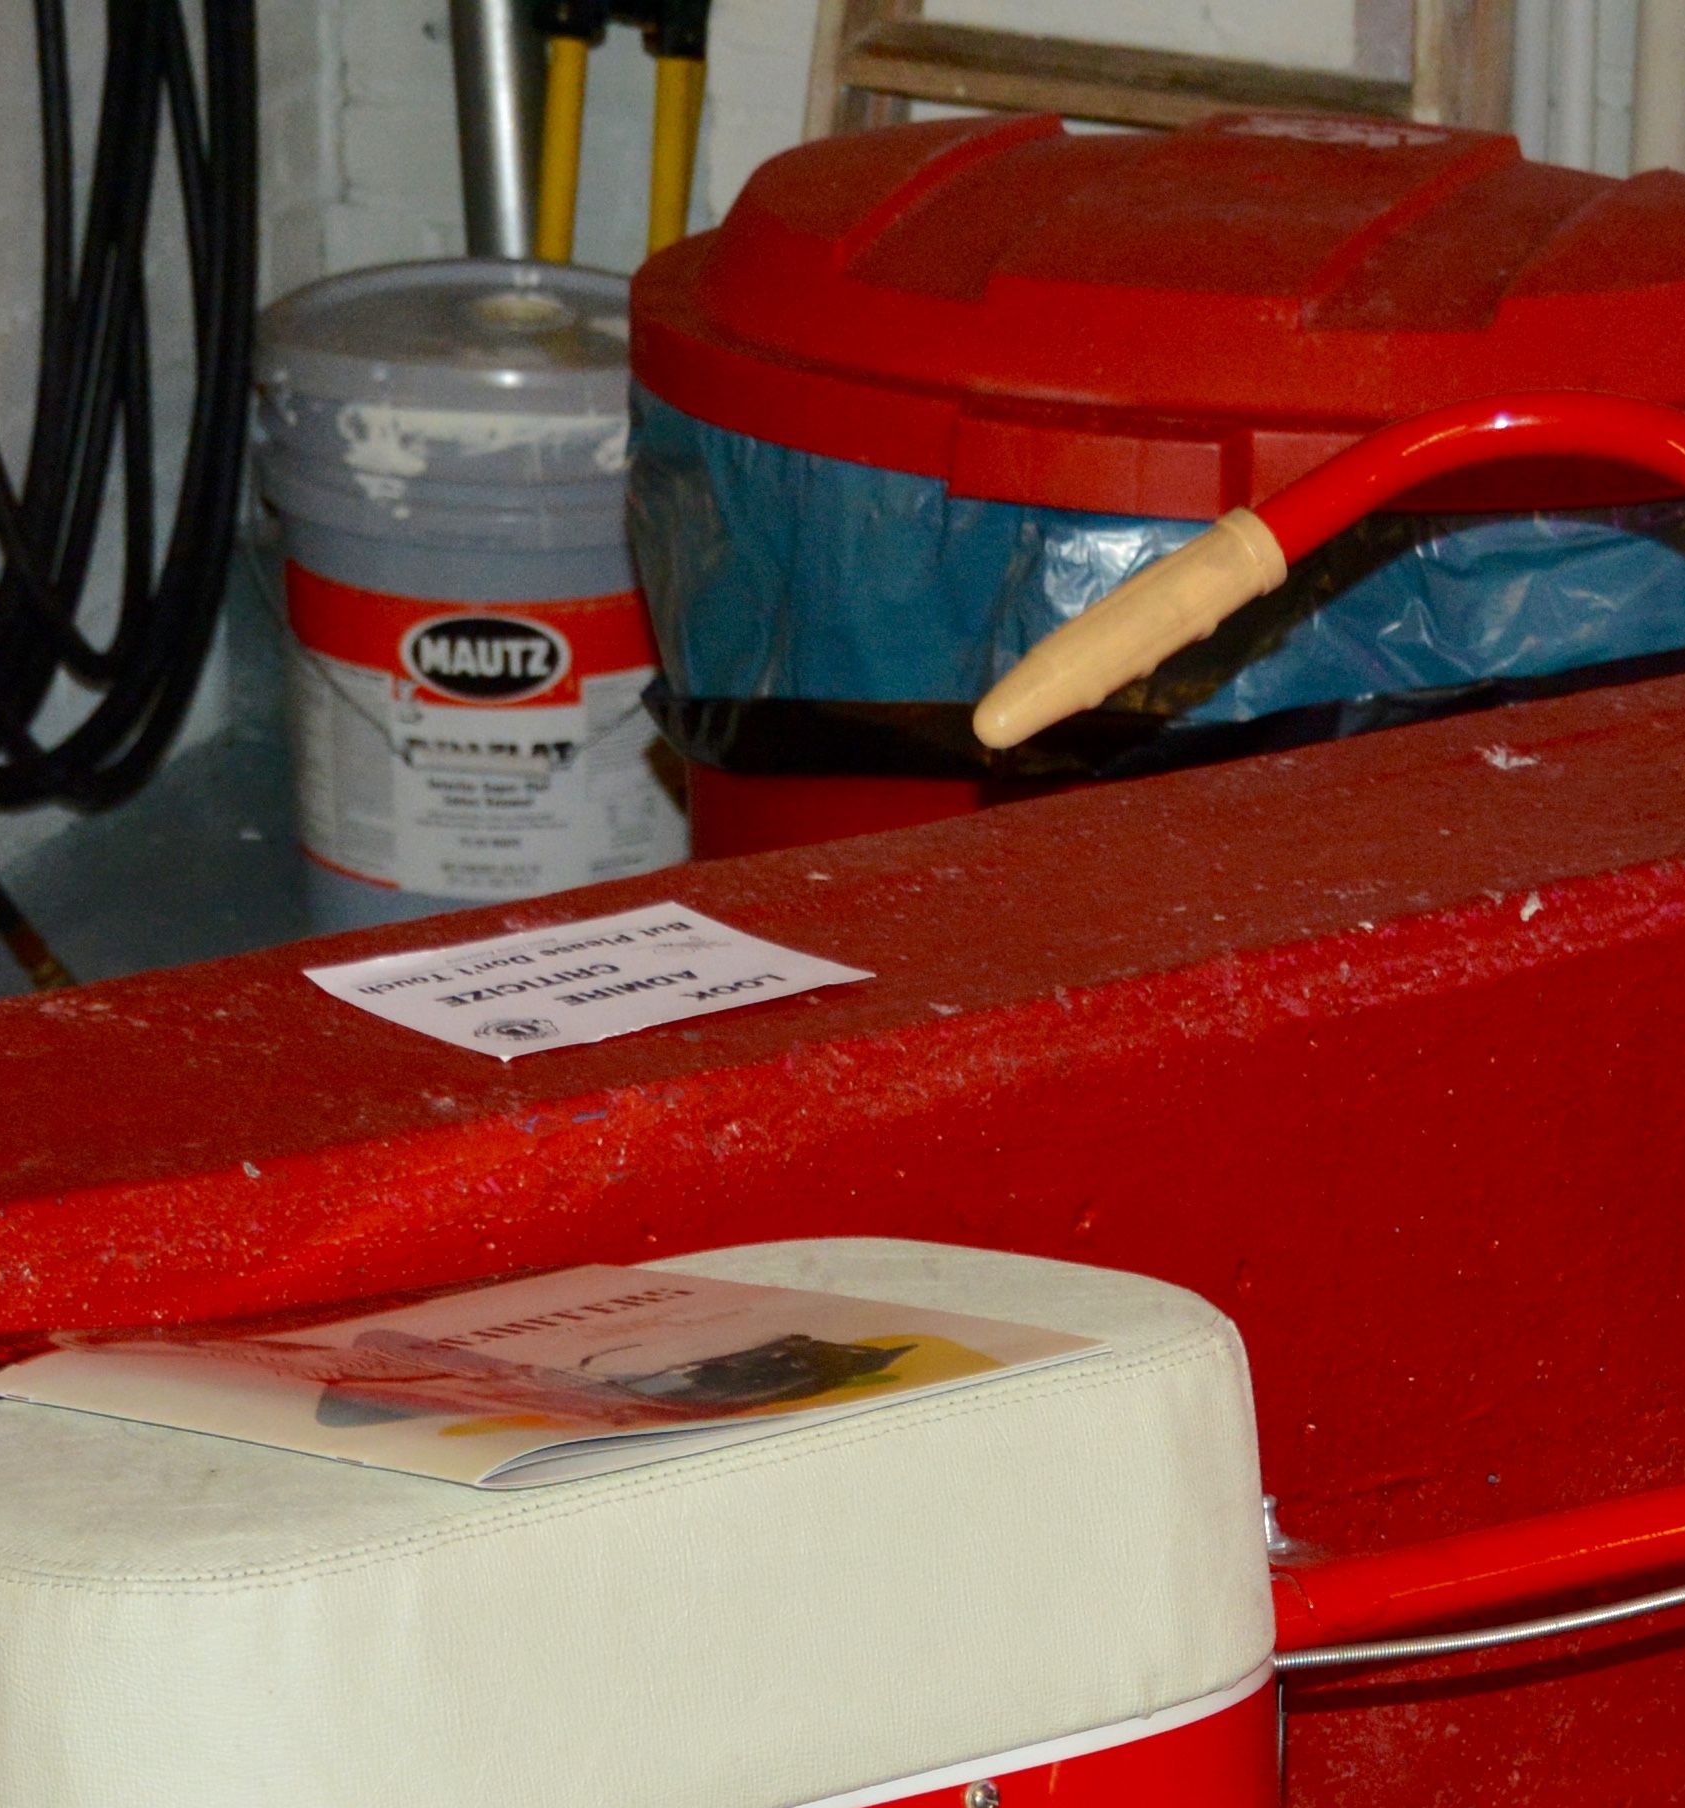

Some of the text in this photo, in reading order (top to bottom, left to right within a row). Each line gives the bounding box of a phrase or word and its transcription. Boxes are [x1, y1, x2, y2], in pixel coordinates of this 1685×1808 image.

[419, 636, 551, 677] MAUTZ
[639, 921, 693, 938] But
[538, 933, 635, 956] Please
[454, 954, 535, 976] Don't
[358, 973, 454, 996] Touch
[435, 963, 621, 1008] CRITICIZE
[554, 969, 699, 1006] ADMIRE
[679, 973, 787, 1001] LOOK
